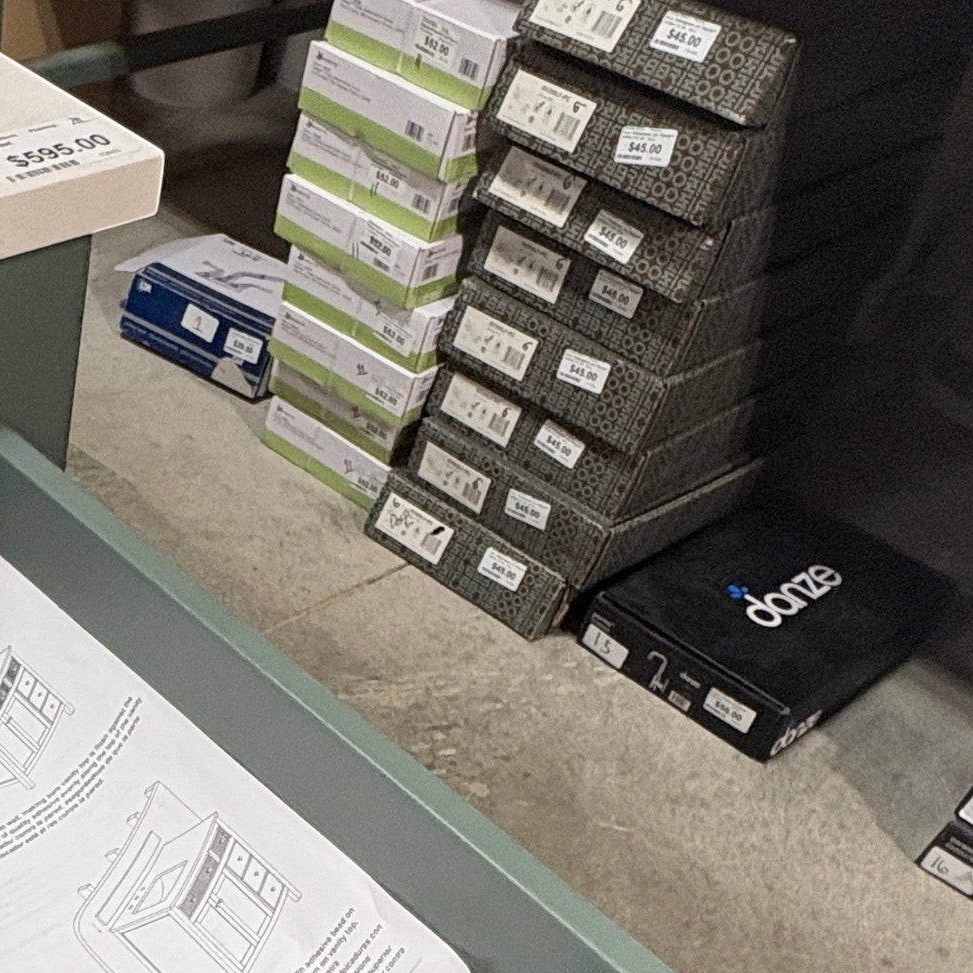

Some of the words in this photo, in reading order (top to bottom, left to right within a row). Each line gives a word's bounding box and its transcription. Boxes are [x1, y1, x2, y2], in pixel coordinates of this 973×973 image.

[666, 28, 702, 48] $45.00
[6, 134, 111, 167] $595.00
[628, 142, 662, 155] $45.00
[599, 226, 627, 249] $45.00
[569, 364, 598, 382] $45.00
[546, 435, 571, 456] $45.00
[743, 564, 842, 628] danze
[305, 937, 332, 968] adhesive
[330, 917, 347, 937] bead
[345, 908, 355, 919] on
[320, 957, 329, 967] on
[328, 935, 347, 957] vanity
